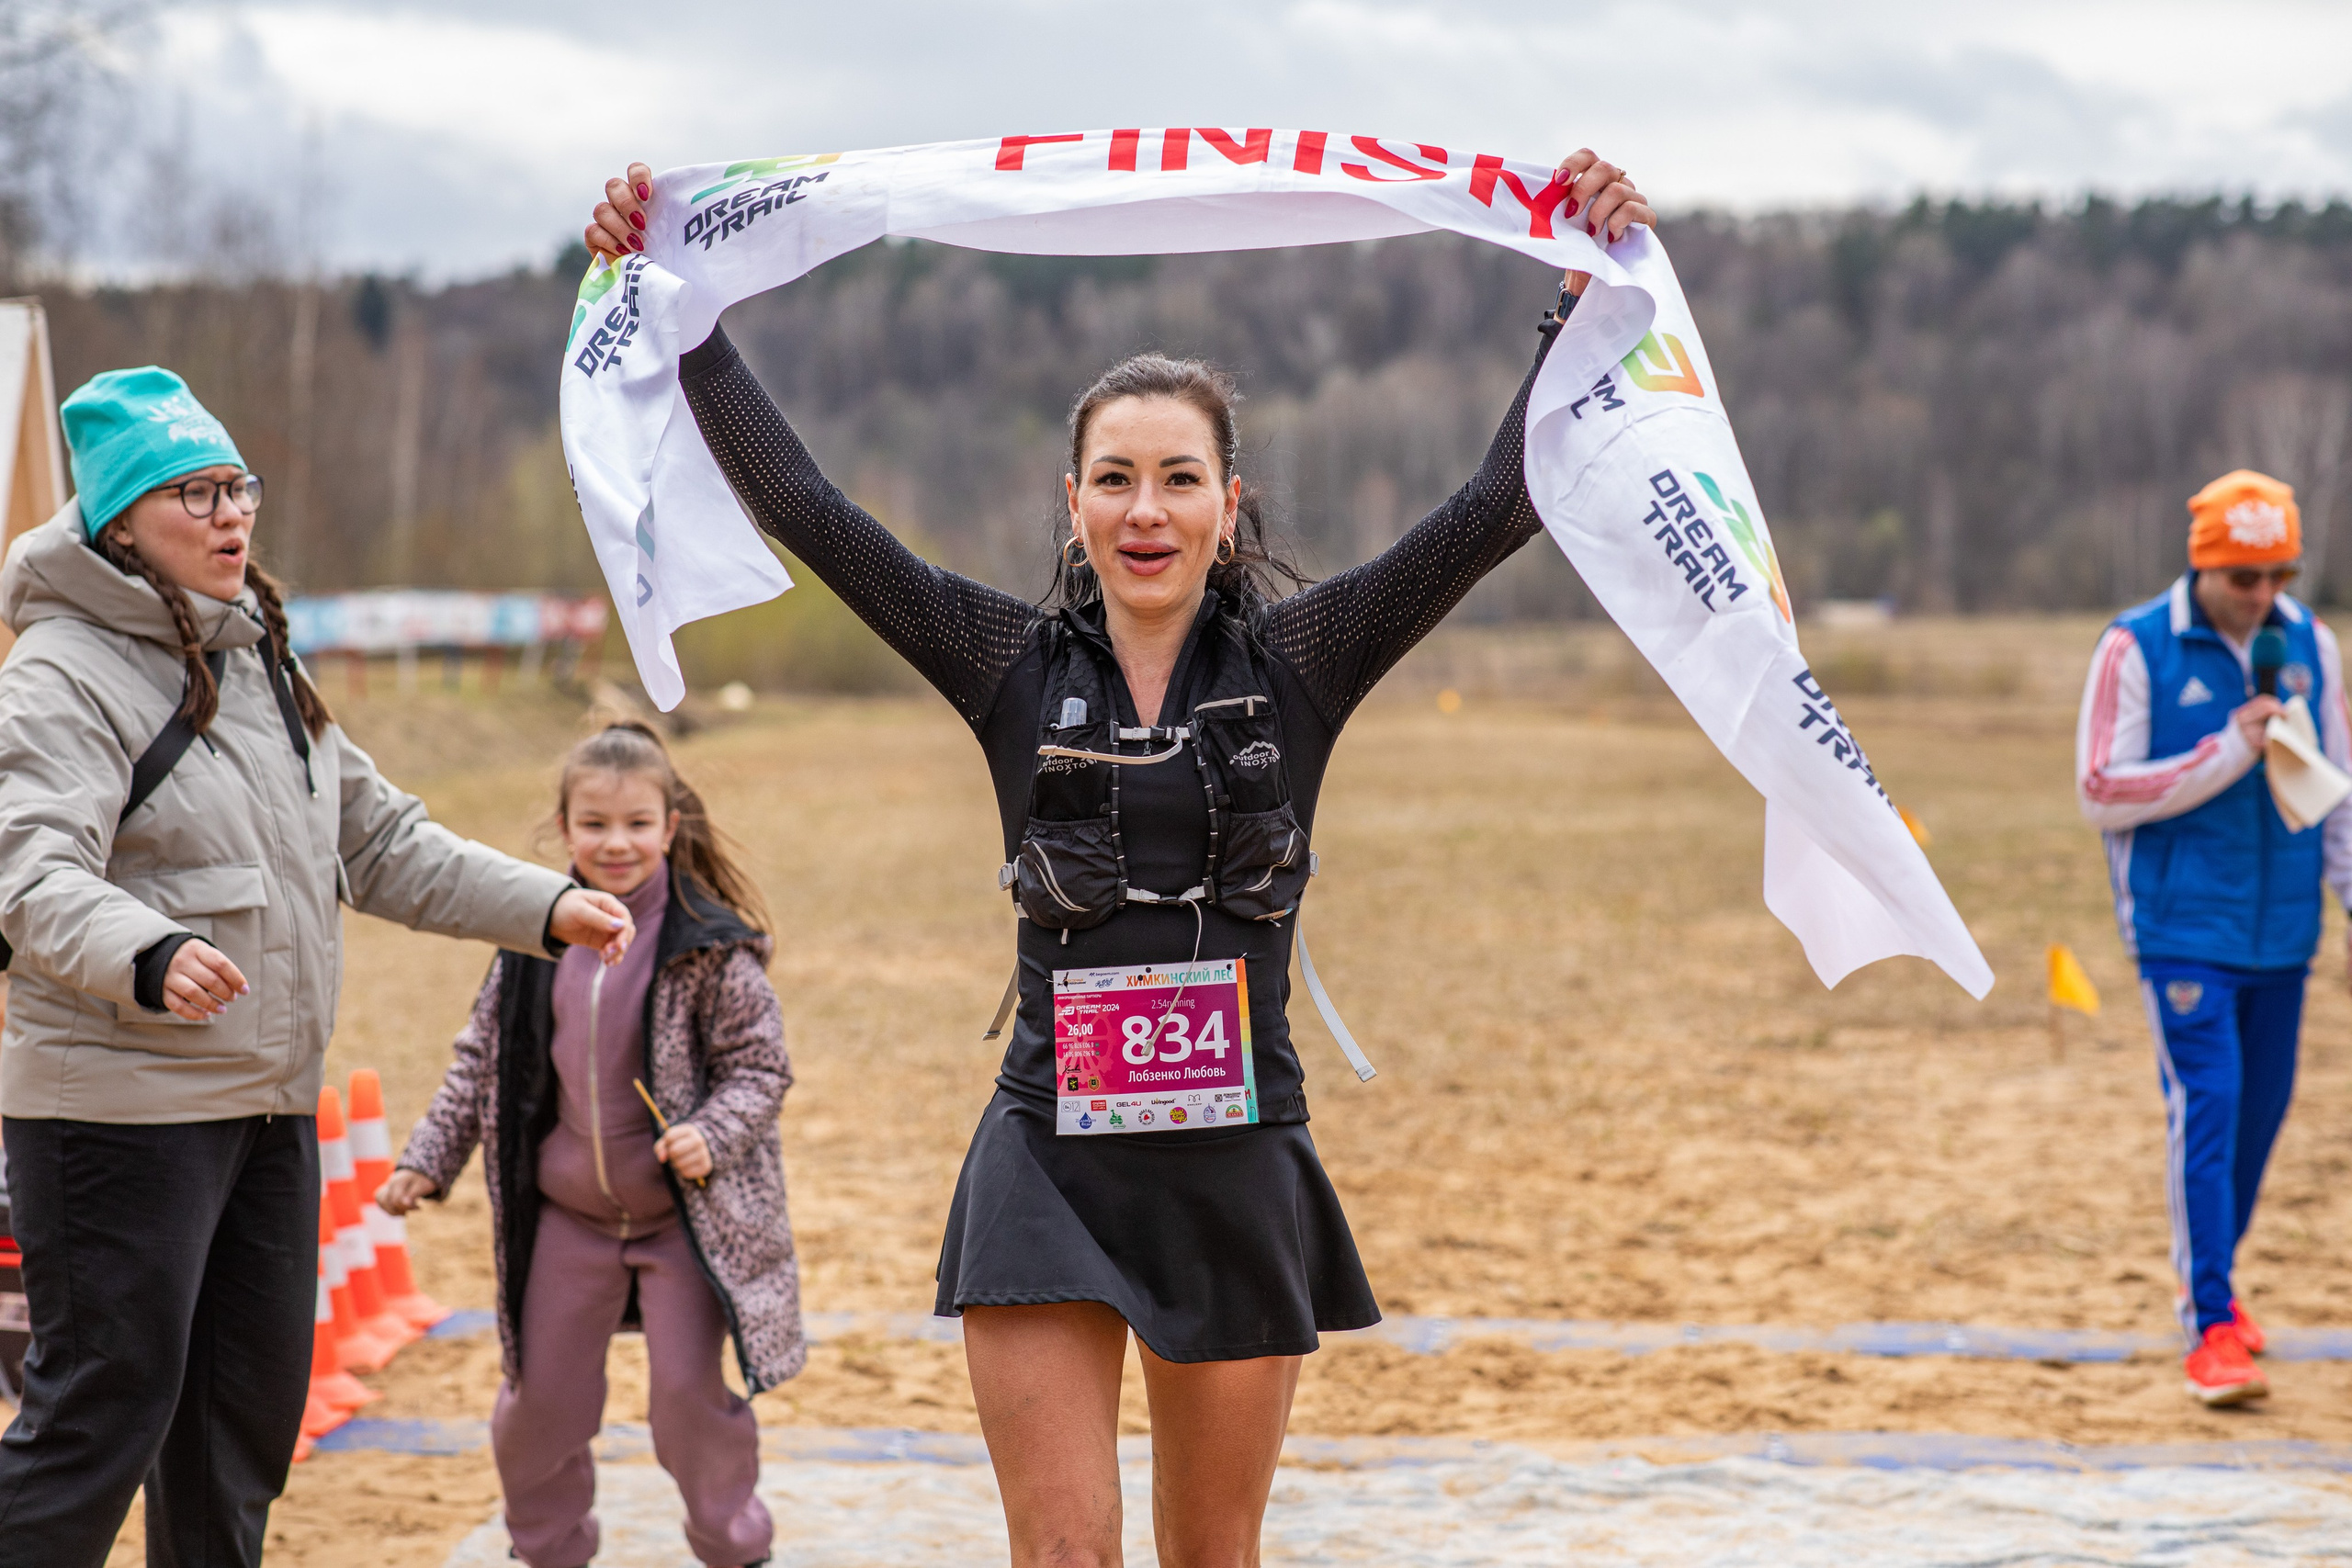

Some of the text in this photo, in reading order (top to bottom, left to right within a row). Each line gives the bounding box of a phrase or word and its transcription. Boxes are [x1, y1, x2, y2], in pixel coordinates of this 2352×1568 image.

[684, 171, 831, 246] DREAM
[698, 190, 808, 252] TRAIL
[1649, 468, 1749, 603] DREAM
[1643, 500, 1715, 614] TRAIL
[1232, 751, 1270, 761] outdoor
[1240, 756, 1277, 768] INOXTO
[1044, 761, 1087, 773] INOXTO
[1125, 966, 1211, 987] ХИМКИНСКИЙ
[1213, 969, 1234, 982] ЛЕС
[1102, 1003, 1120, 1012] 2024
[1067, 1022, 1093, 1038] 26,00
[1121, 1010, 1230, 1066] 834
[1127, 1065, 1227, 1083] Лобзенко Любовь
